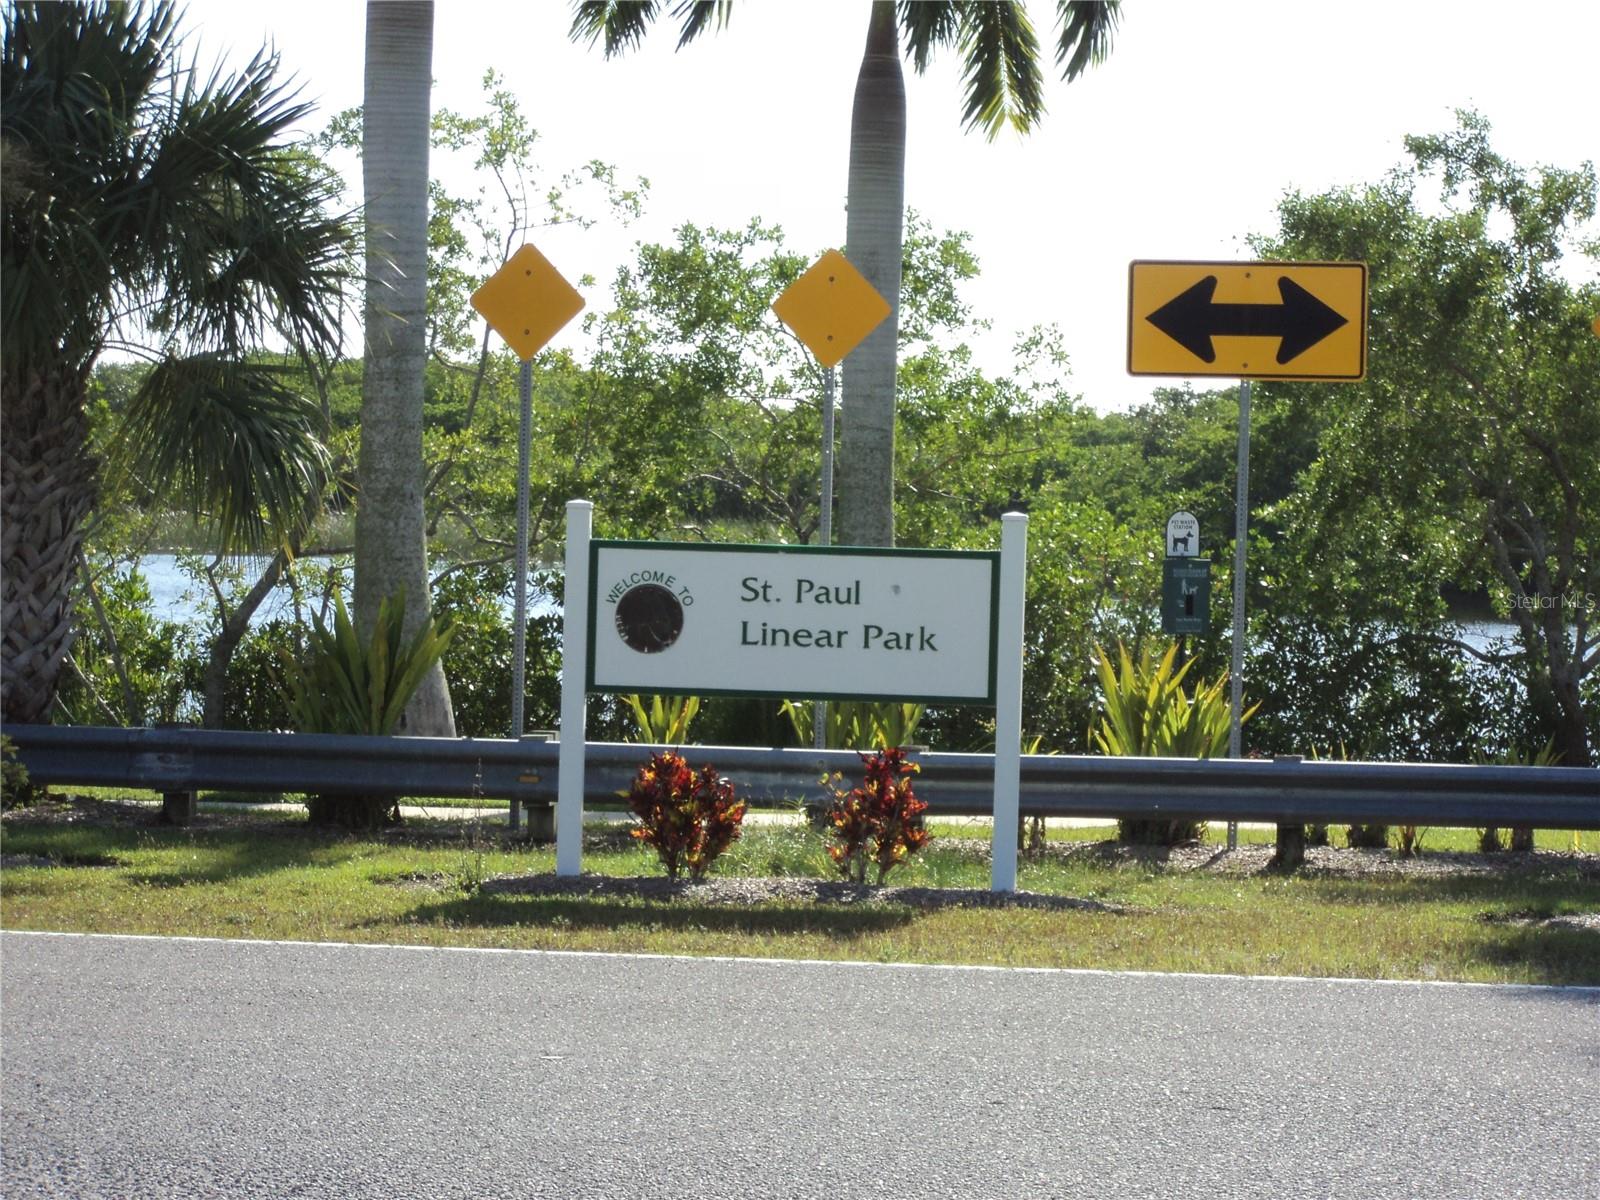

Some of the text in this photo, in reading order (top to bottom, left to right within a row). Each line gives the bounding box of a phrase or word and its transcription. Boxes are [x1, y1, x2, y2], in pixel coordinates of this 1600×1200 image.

[606, 570, 694, 606] WELCOME TO
[740, 576, 861, 605] St. Paul
[740, 621, 939, 652] Linear Park
